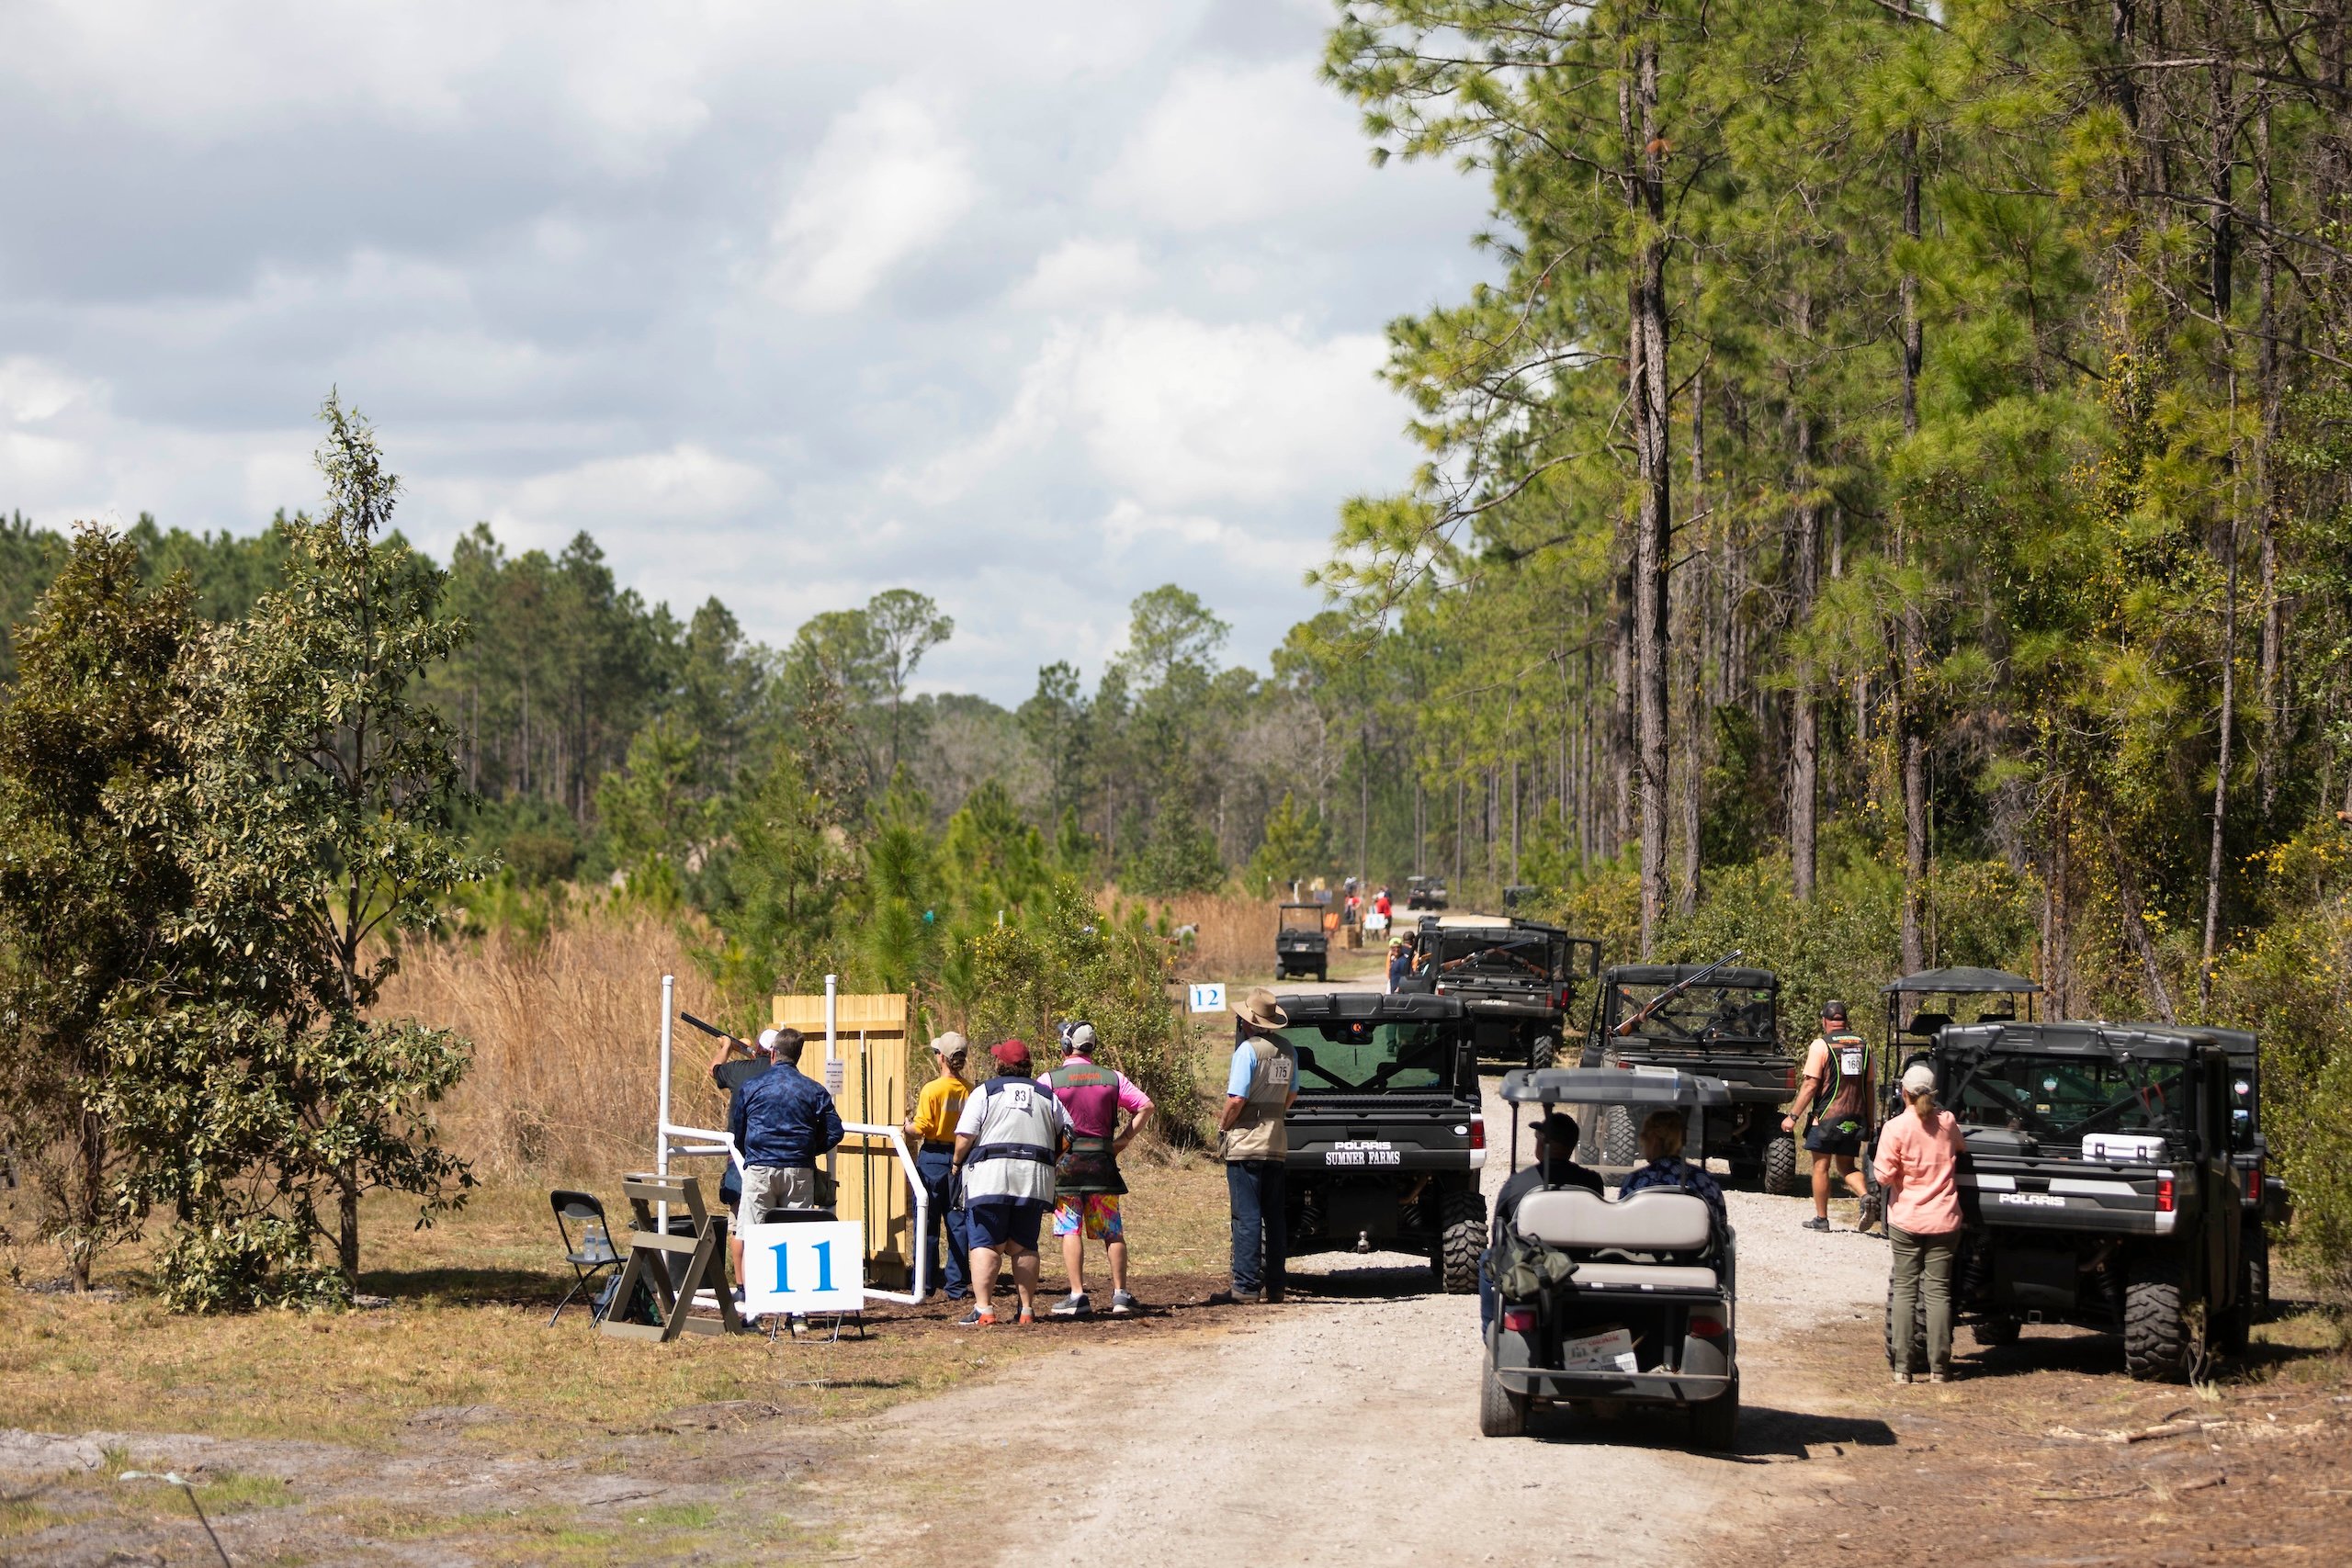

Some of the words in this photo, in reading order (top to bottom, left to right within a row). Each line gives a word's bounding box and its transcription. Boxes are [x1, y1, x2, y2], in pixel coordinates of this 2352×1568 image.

[1196, 989, 1218, 1006] 12
[1847, 1060, 1860, 1069] 160
[1275, 1066, 1287, 1077] 175
[1014, 1089, 1026, 1101] 83
[1334, 1142, 1392, 1150] POLARIS
[1326, 1152, 1365, 1165] SUMNER
[1368, 1151, 1400, 1165] FARMS
[1998, 1193, 2065, 1206] POLARIS
[768, 1240, 839, 1293] 11
